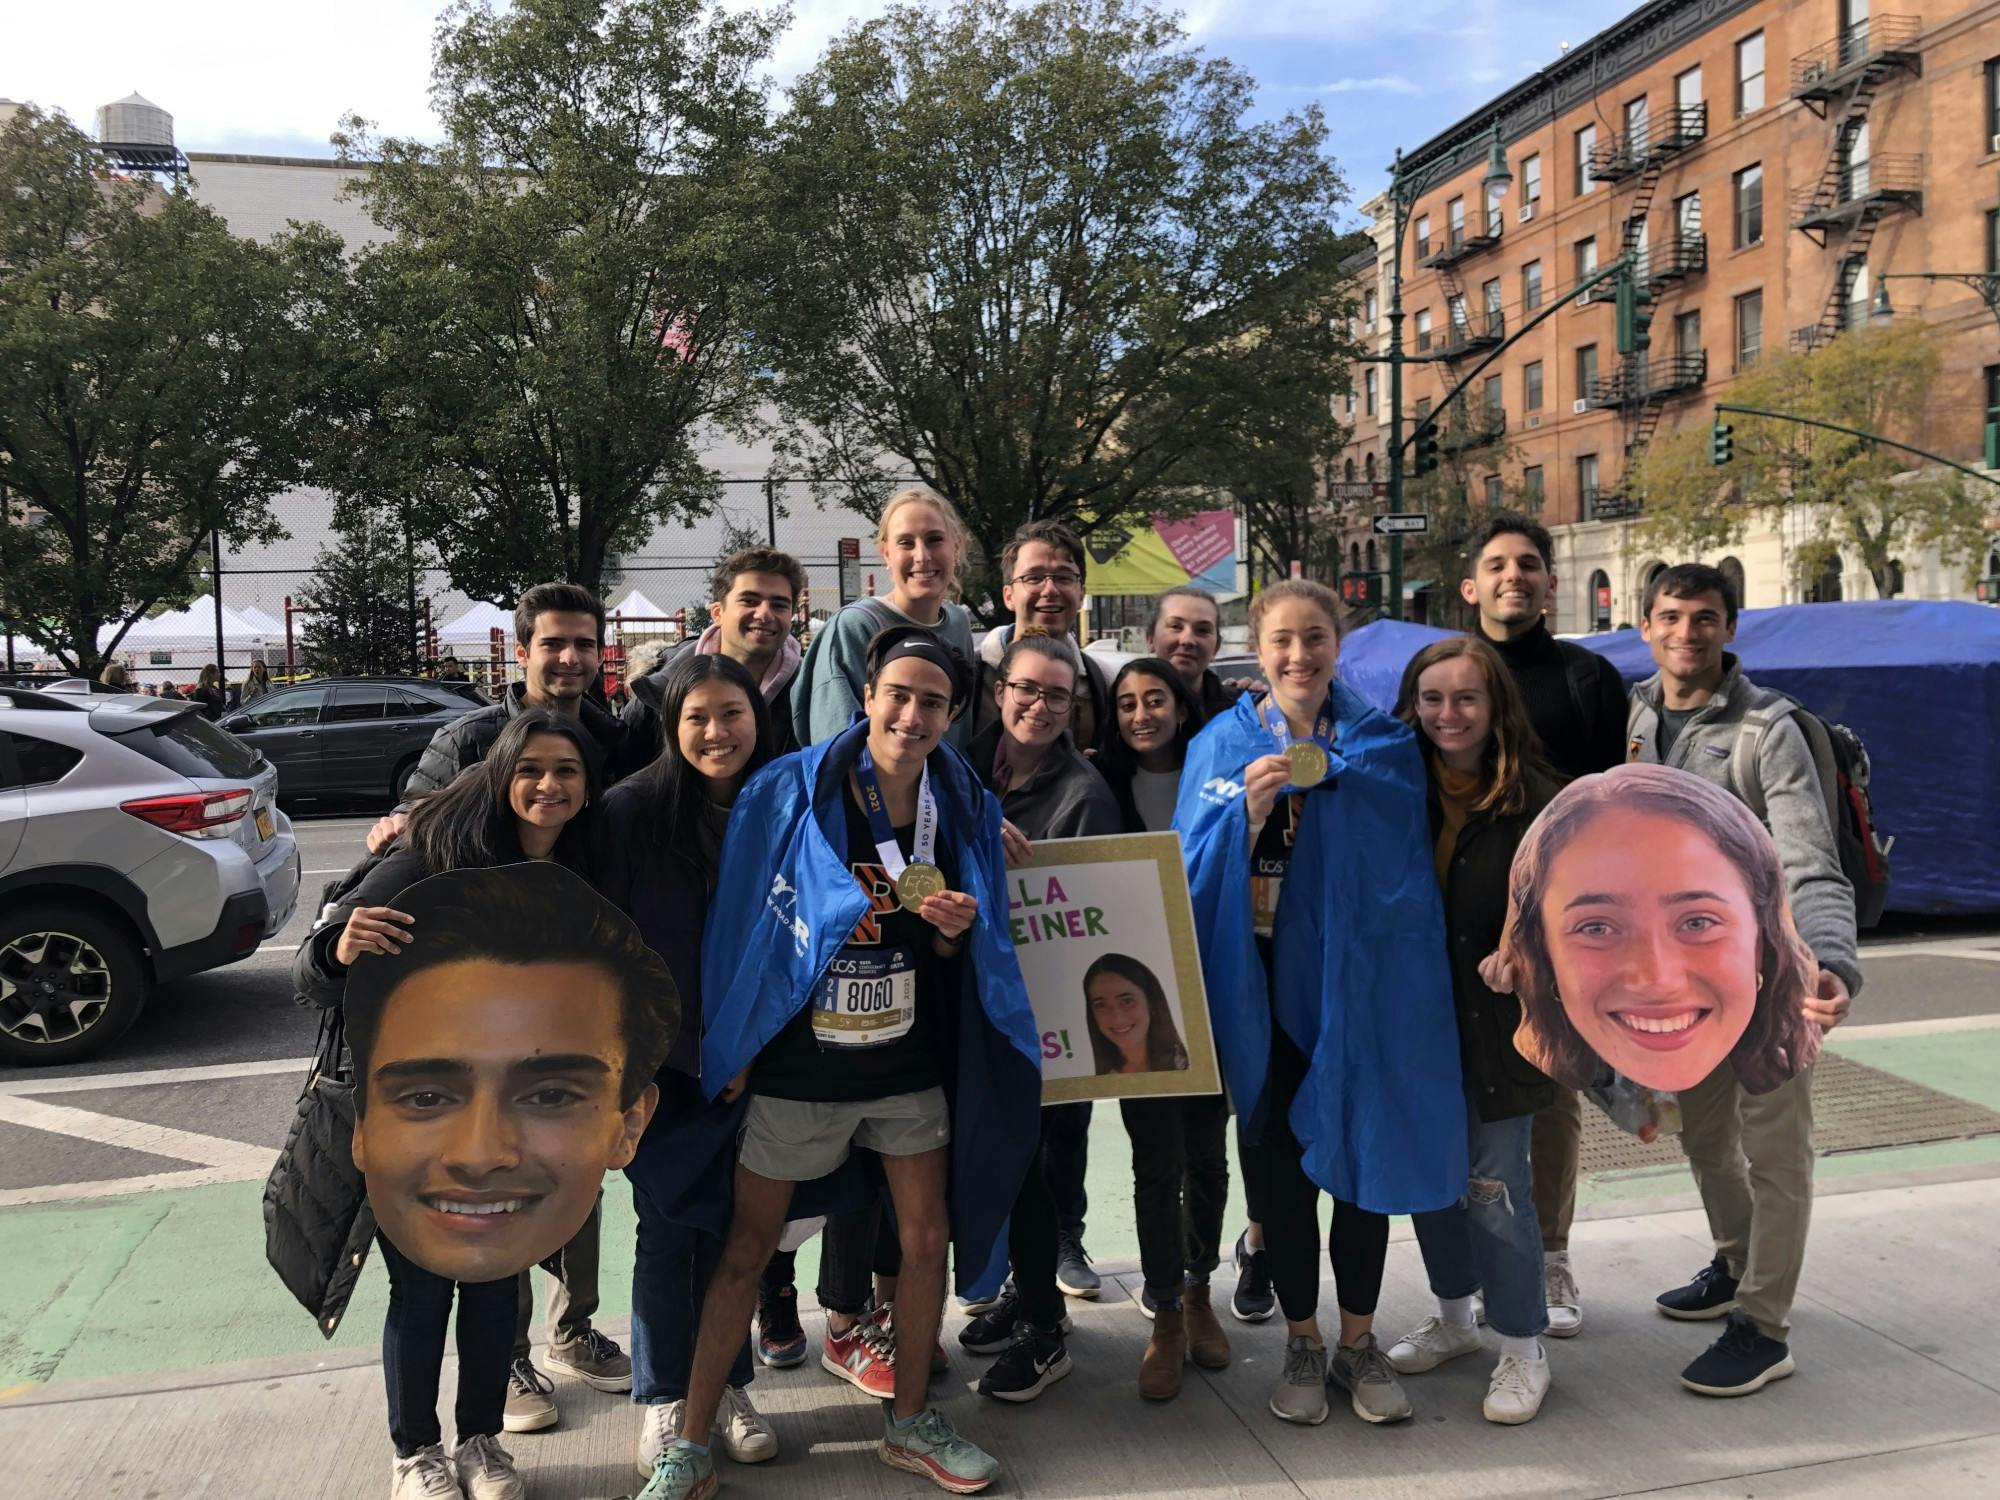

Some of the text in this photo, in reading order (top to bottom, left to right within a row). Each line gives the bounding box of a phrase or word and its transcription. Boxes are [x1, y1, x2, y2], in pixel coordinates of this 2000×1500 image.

[1332, 485, 1374, 497] COLUMBUS
[1381, 520, 1396, 528] ONE
[865, 785, 881, 813] 2021
[921, 834, 929, 847] 50
[1009, 906, 1109, 946] EINER
[825, 996, 833, 1011] A
[847, 978, 893, 1013] 8060
[1041, 1029, 1074, 1060] S!
